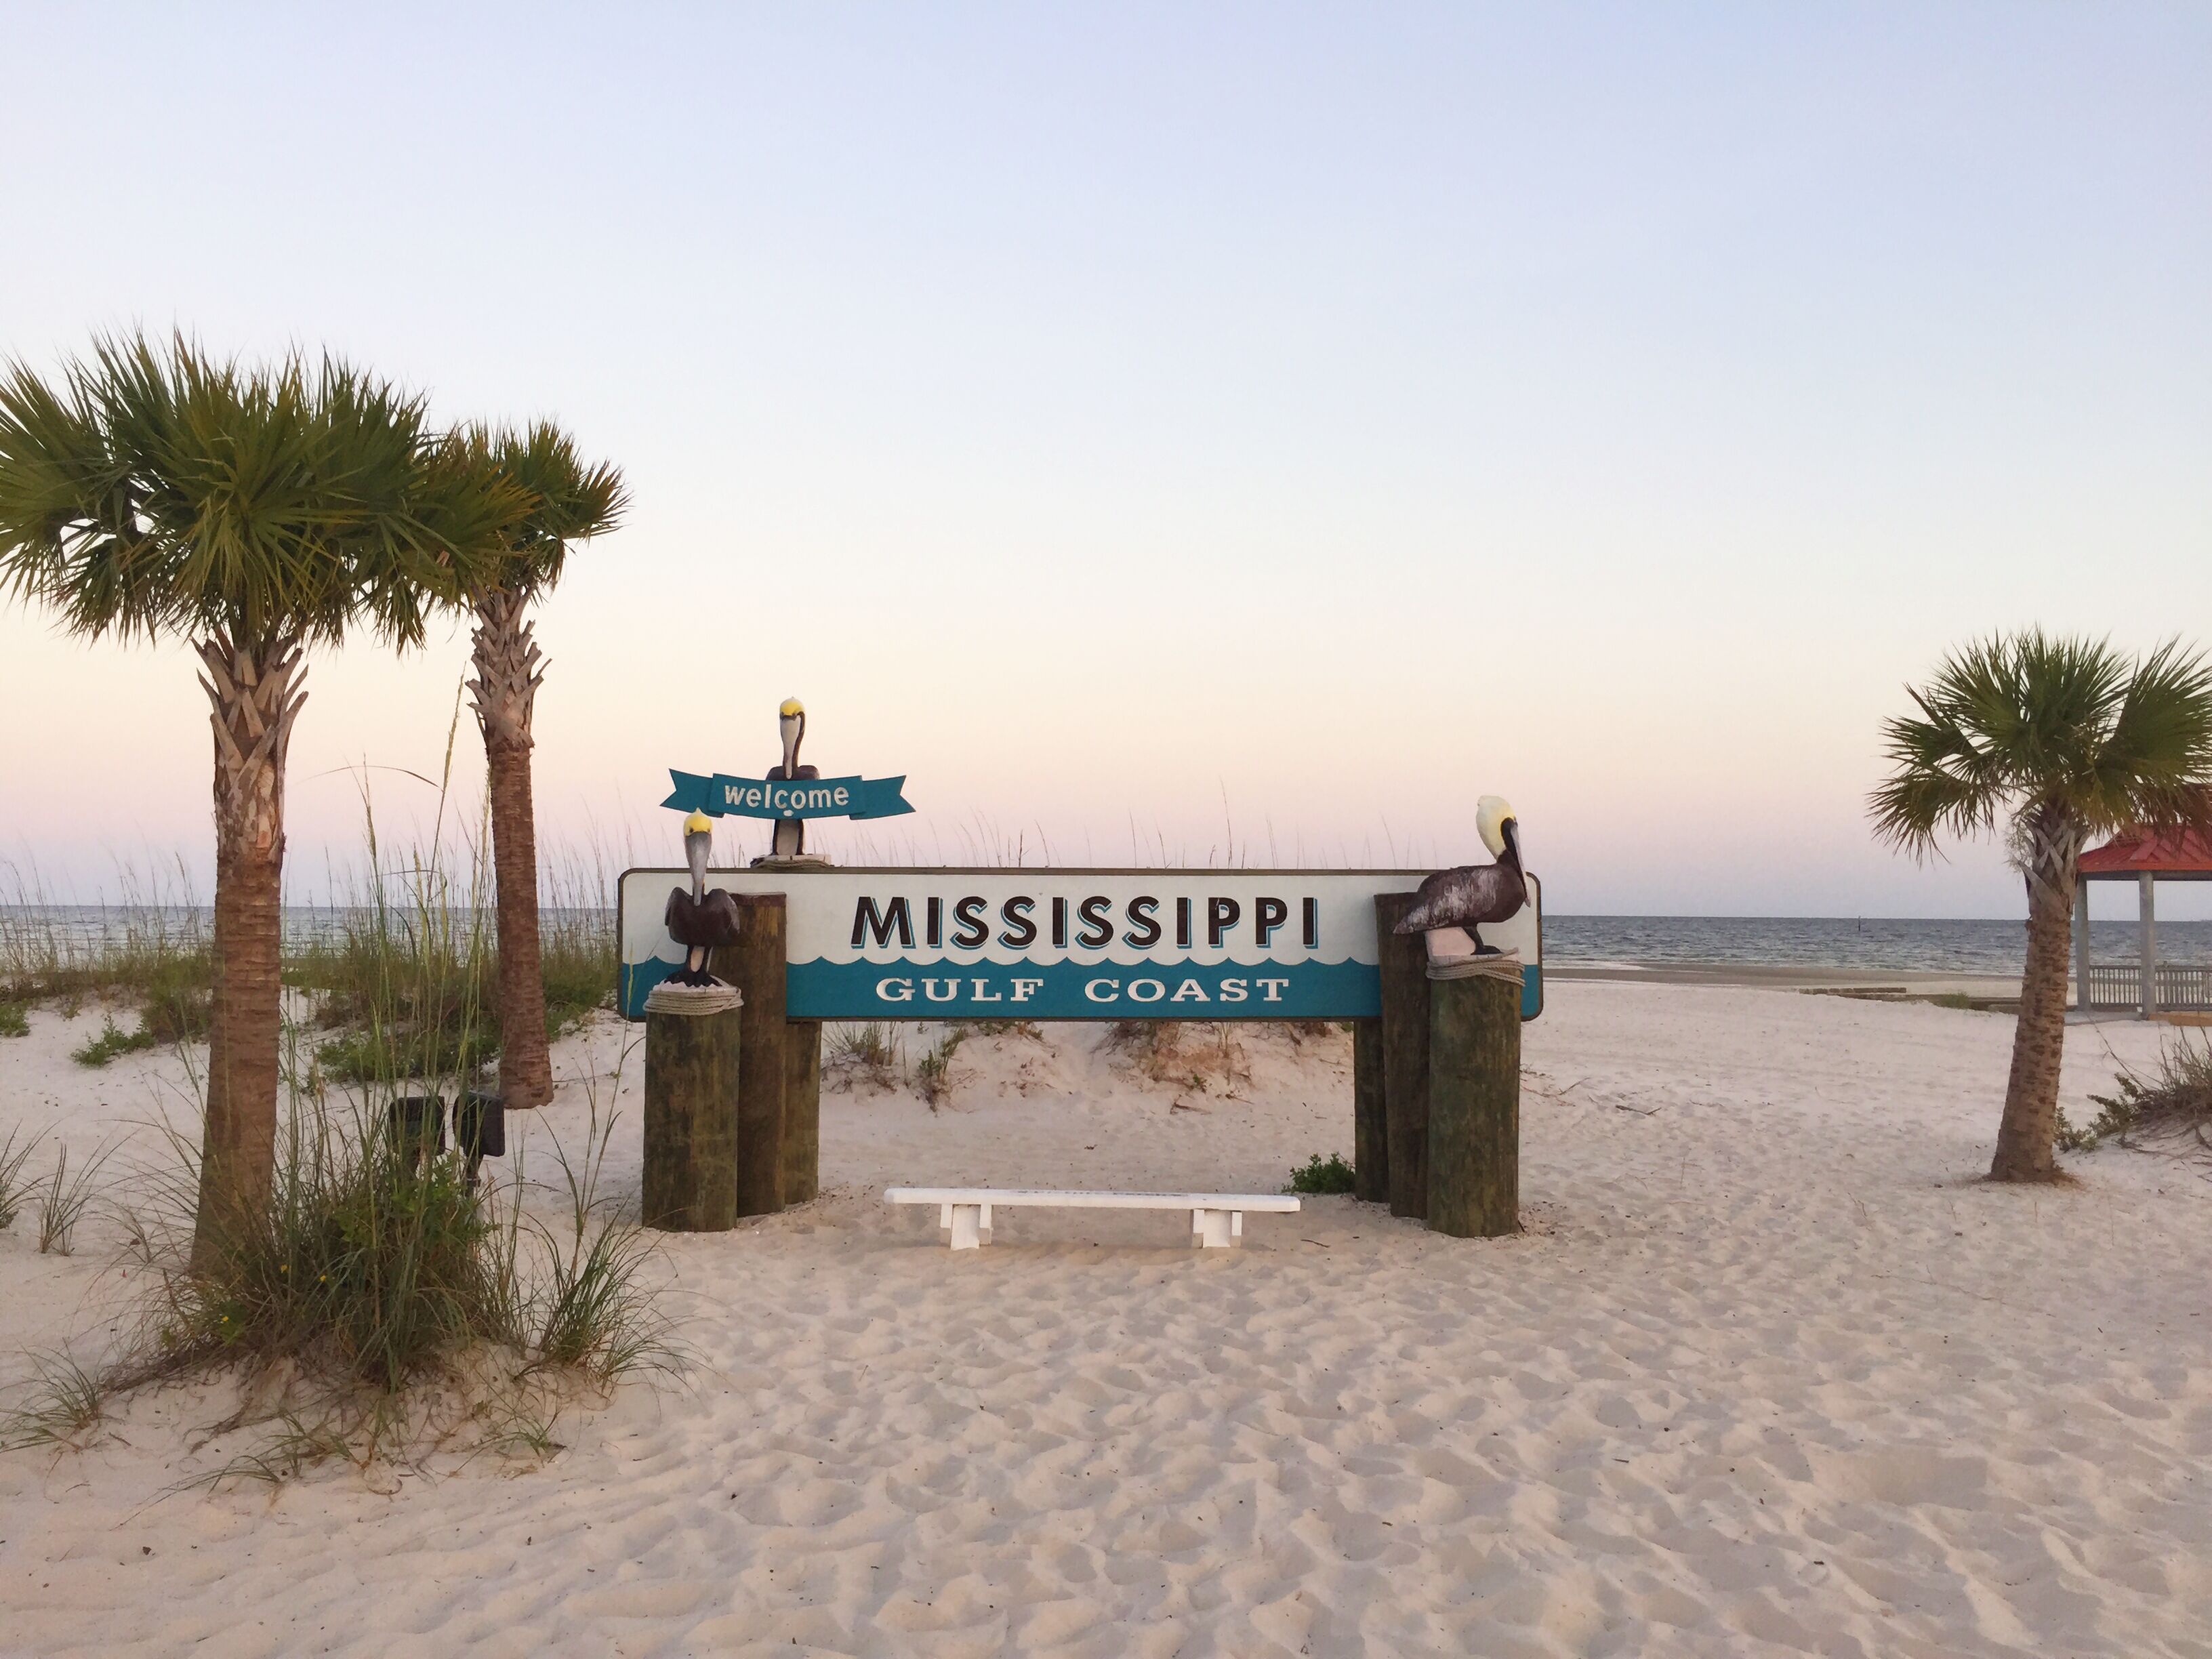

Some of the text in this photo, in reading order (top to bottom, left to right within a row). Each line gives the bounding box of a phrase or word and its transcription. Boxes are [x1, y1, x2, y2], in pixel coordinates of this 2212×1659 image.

[724, 783, 850, 810] welcome
[851, 896, 1318, 949] MISSISSIPPI
[876, 977, 1290, 1003] GULF COAST
